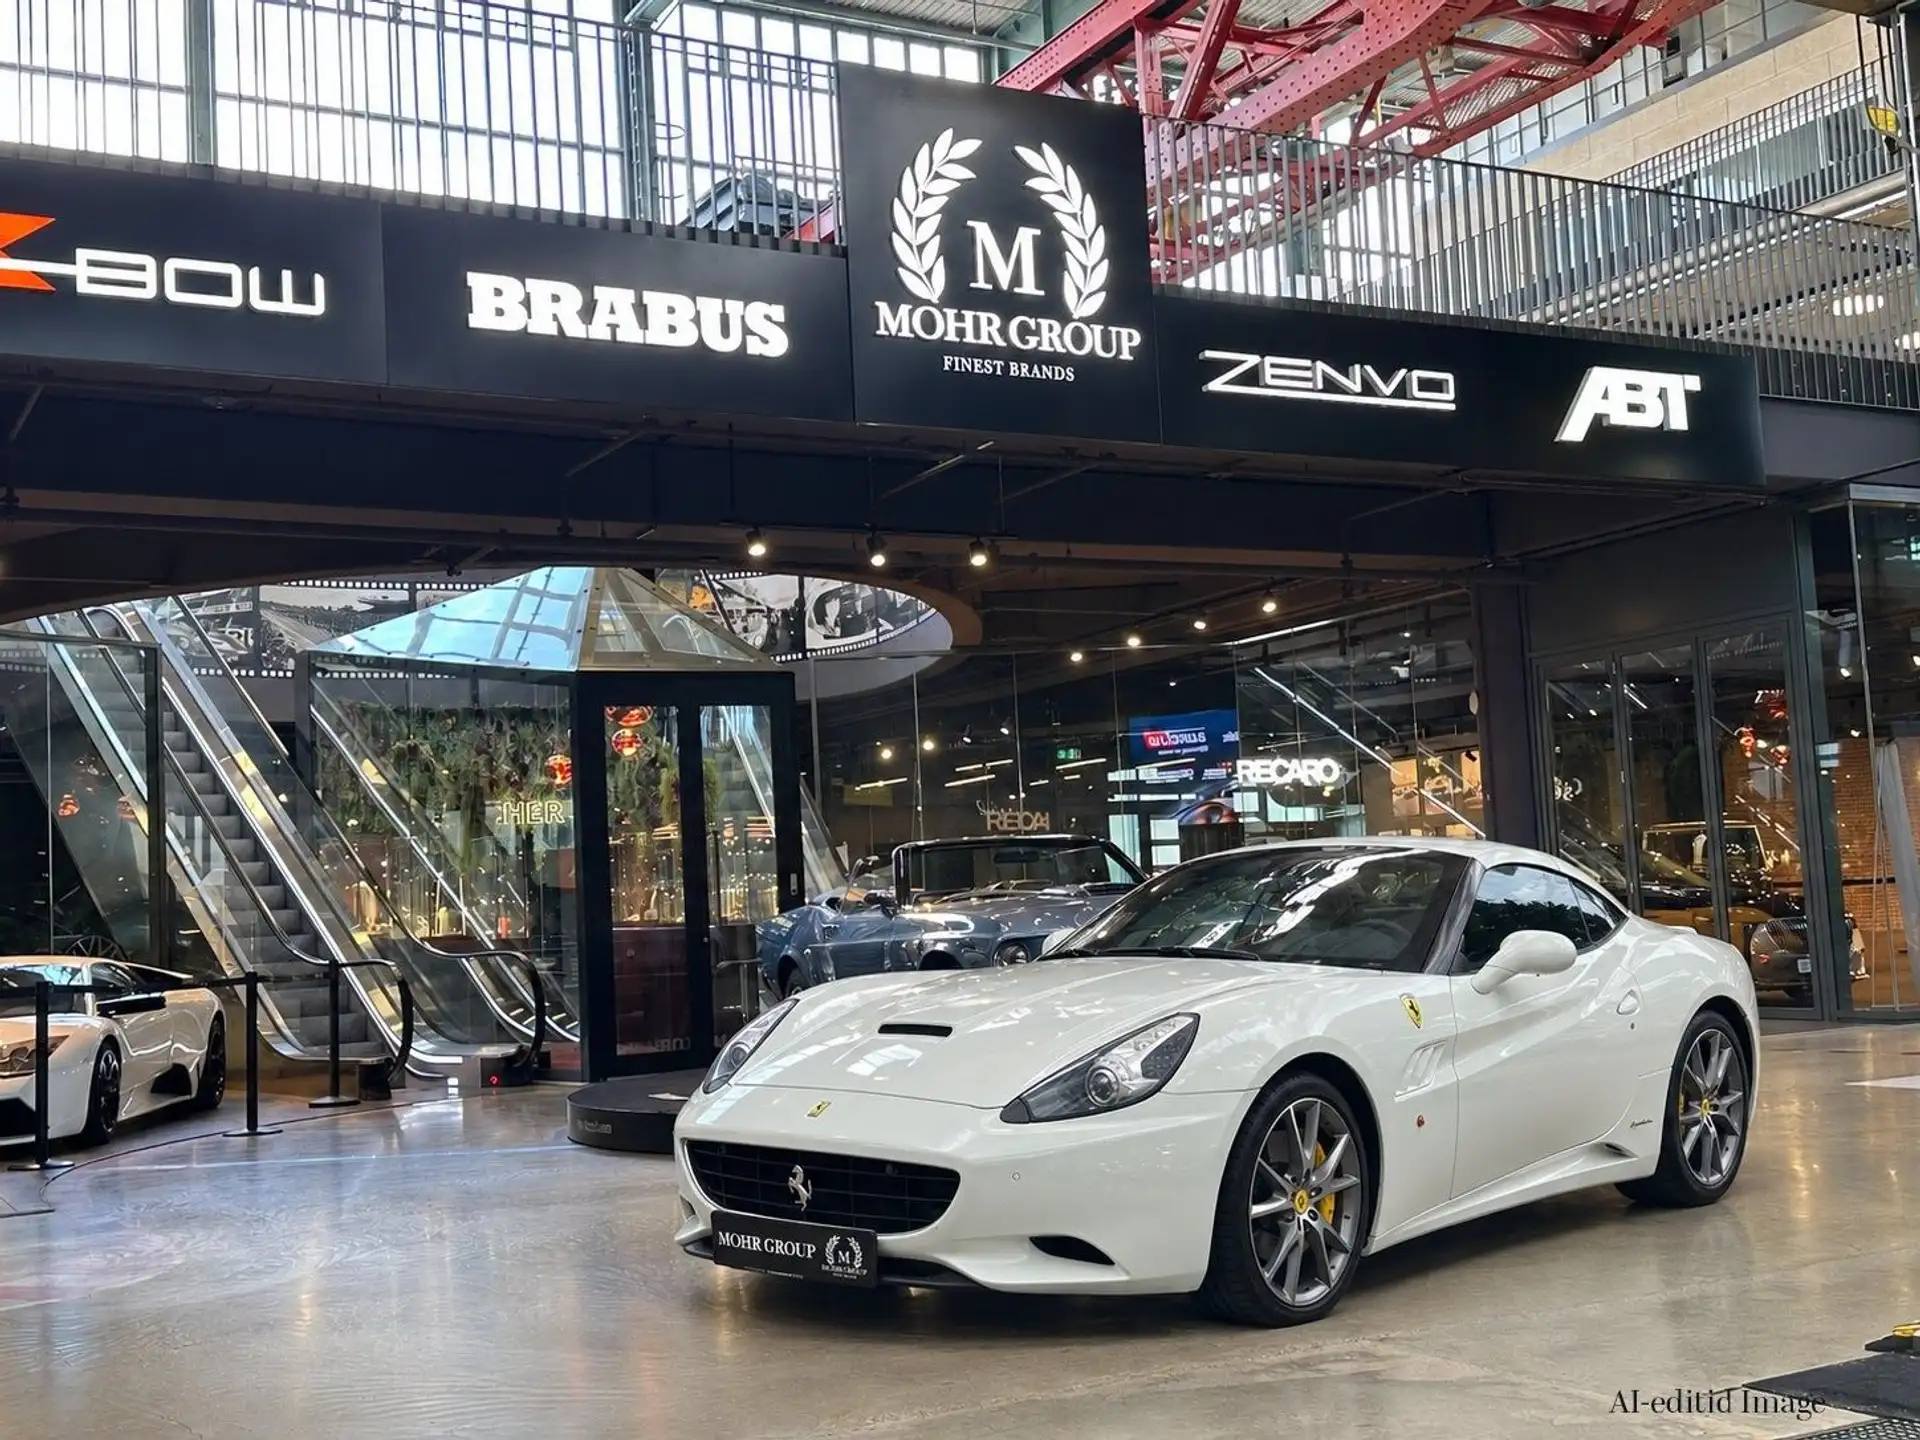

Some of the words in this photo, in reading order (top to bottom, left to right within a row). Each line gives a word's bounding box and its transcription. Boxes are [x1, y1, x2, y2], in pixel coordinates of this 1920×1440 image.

[967, 220, 1045, 296] M
[466, 271, 789, 359] BRABUS
[874, 301, 1007, 347] MOHR
[1008, 315, 1141, 361] GROUP
[943, 355, 1004, 376] FINEST
[1009, 361, 1075, 382] BRANDS
[1200, 349, 1456, 411] ZENVO
[1554, 365, 1701, 442] ABT
[1237, 757, 1340, 787] RECARO
[718, 1231, 762, 1252] MOHR
[763, 1238, 816, 1259] GROUP
